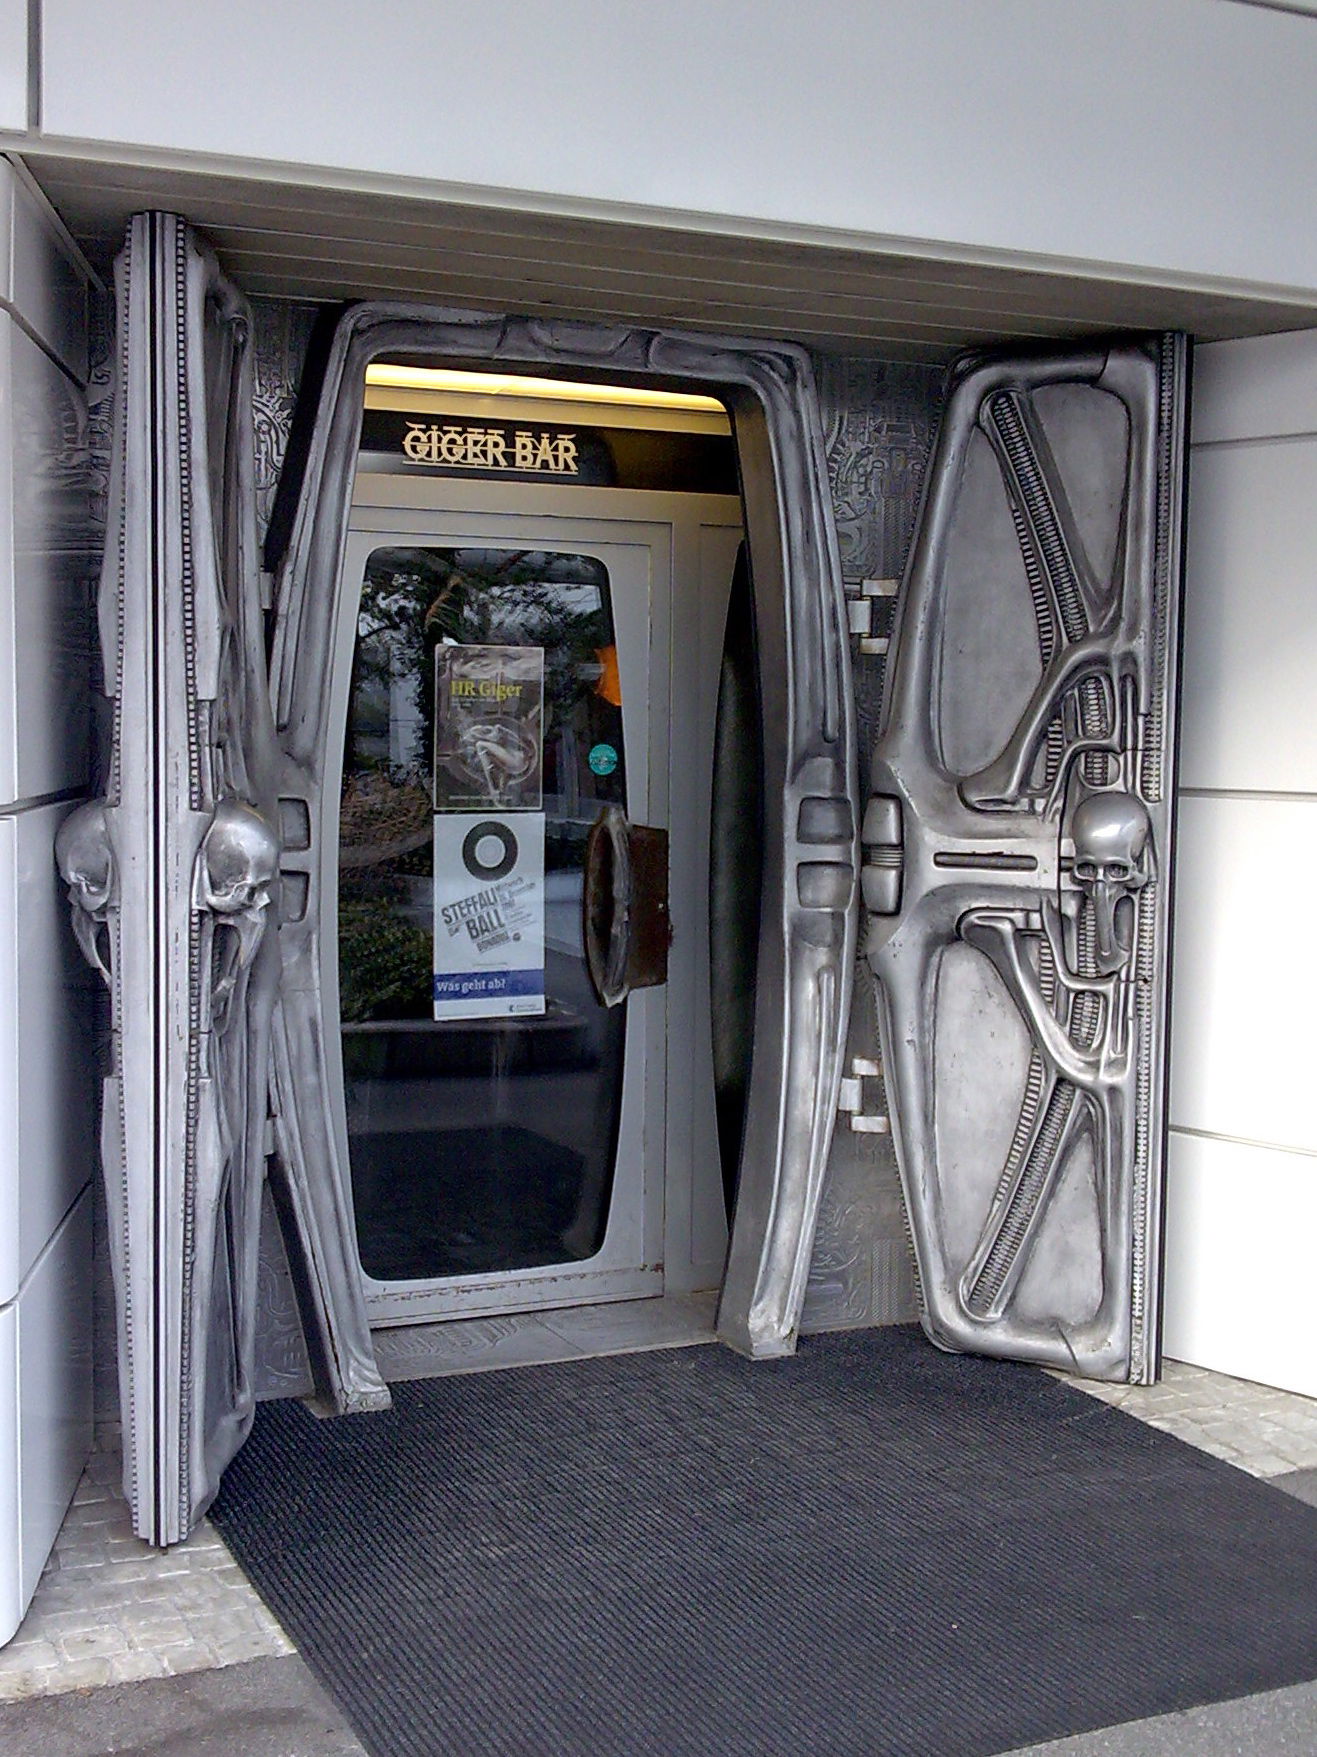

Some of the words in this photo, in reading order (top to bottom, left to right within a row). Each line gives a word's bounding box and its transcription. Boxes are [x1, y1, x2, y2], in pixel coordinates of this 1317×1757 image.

[403, 421, 508, 467] GIGER
[515, 430, 578, 472] BAR
[451, 680, 476, 697] HR
[479, 680, 523, 702] Giger
[441, 887, 498, 925] STEFFALI
[465, 908, 506, 941] BALL
[436, 981, 461, 992] Was
[461, 979, 486, 994] geht
